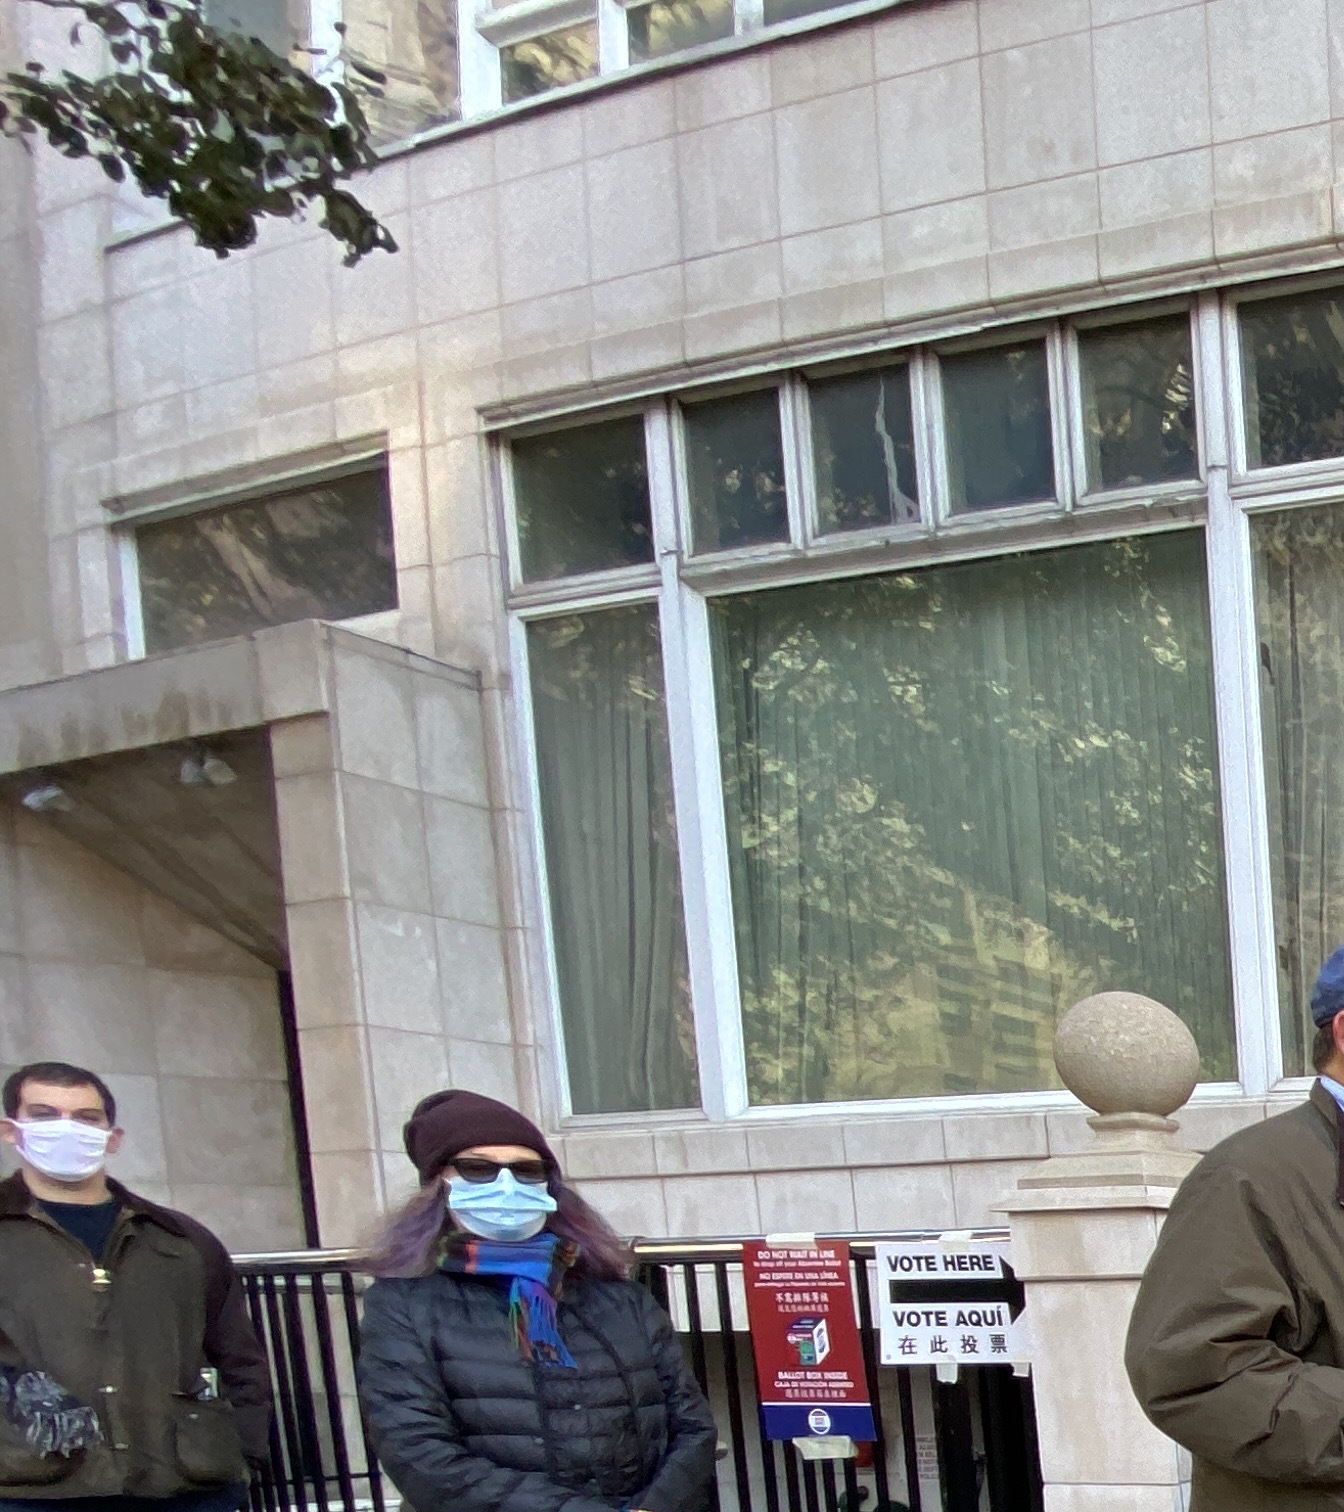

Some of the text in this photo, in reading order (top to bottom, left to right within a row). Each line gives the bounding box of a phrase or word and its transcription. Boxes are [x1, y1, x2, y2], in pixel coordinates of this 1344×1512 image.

[886, 1254, 995, 1272] VOTE HERE
[892, 1305, 1003, 1328] VOTE AQUÍ
[898, 1333, 1008, 1356] 在此投票
